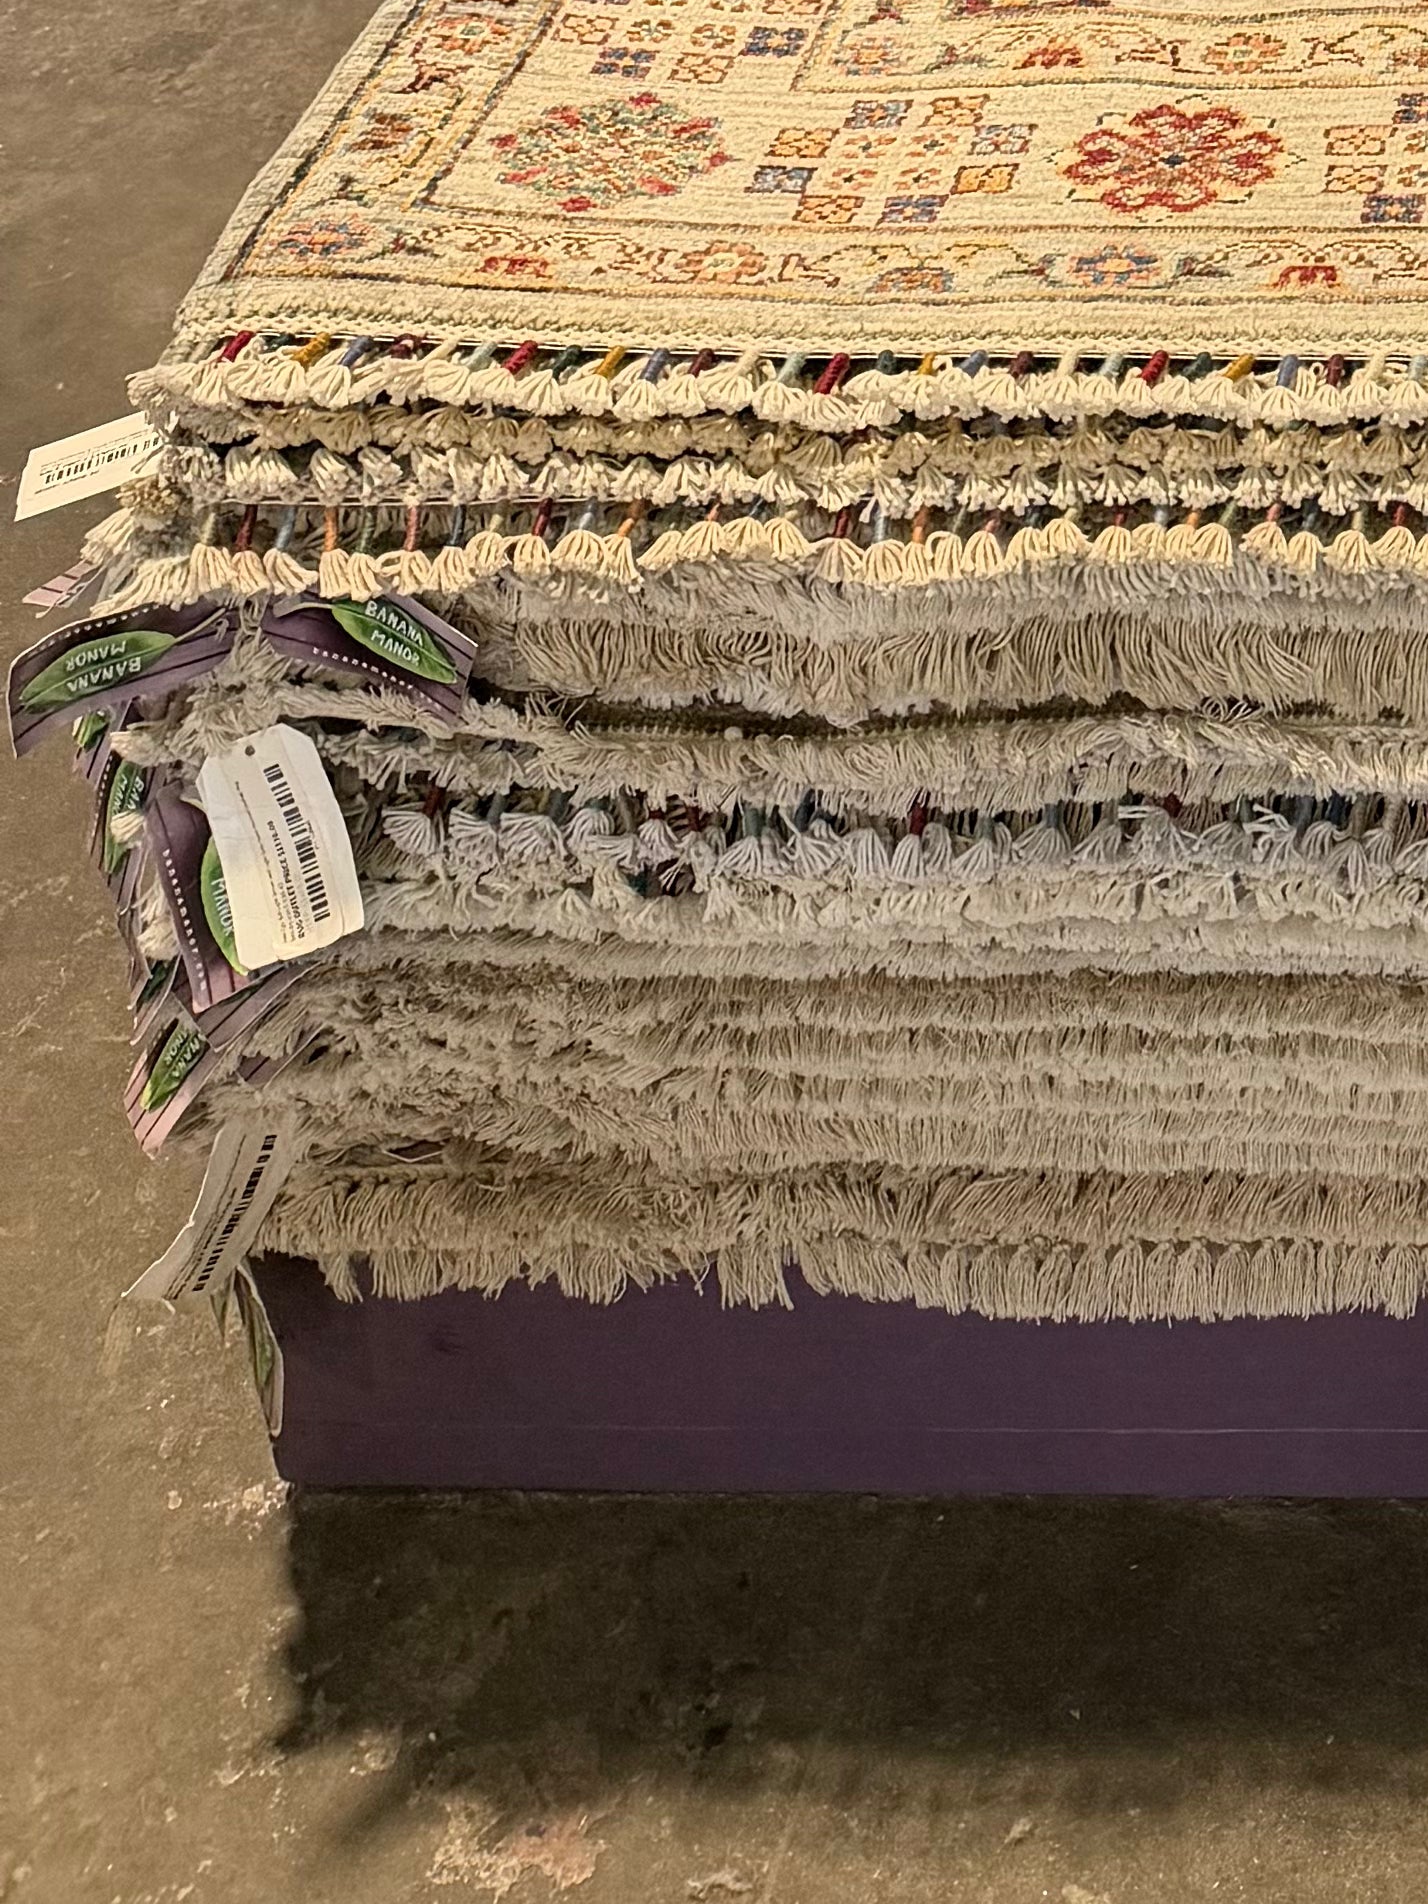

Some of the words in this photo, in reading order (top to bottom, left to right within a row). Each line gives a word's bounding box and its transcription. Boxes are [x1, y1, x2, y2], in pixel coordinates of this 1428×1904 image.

[364, 599, 424, 646] BANANA
[66, 640, 127, 672] MANOR
[370, 629, 421, 667] MANOR
[66, 656, 142, 692] BANANA
